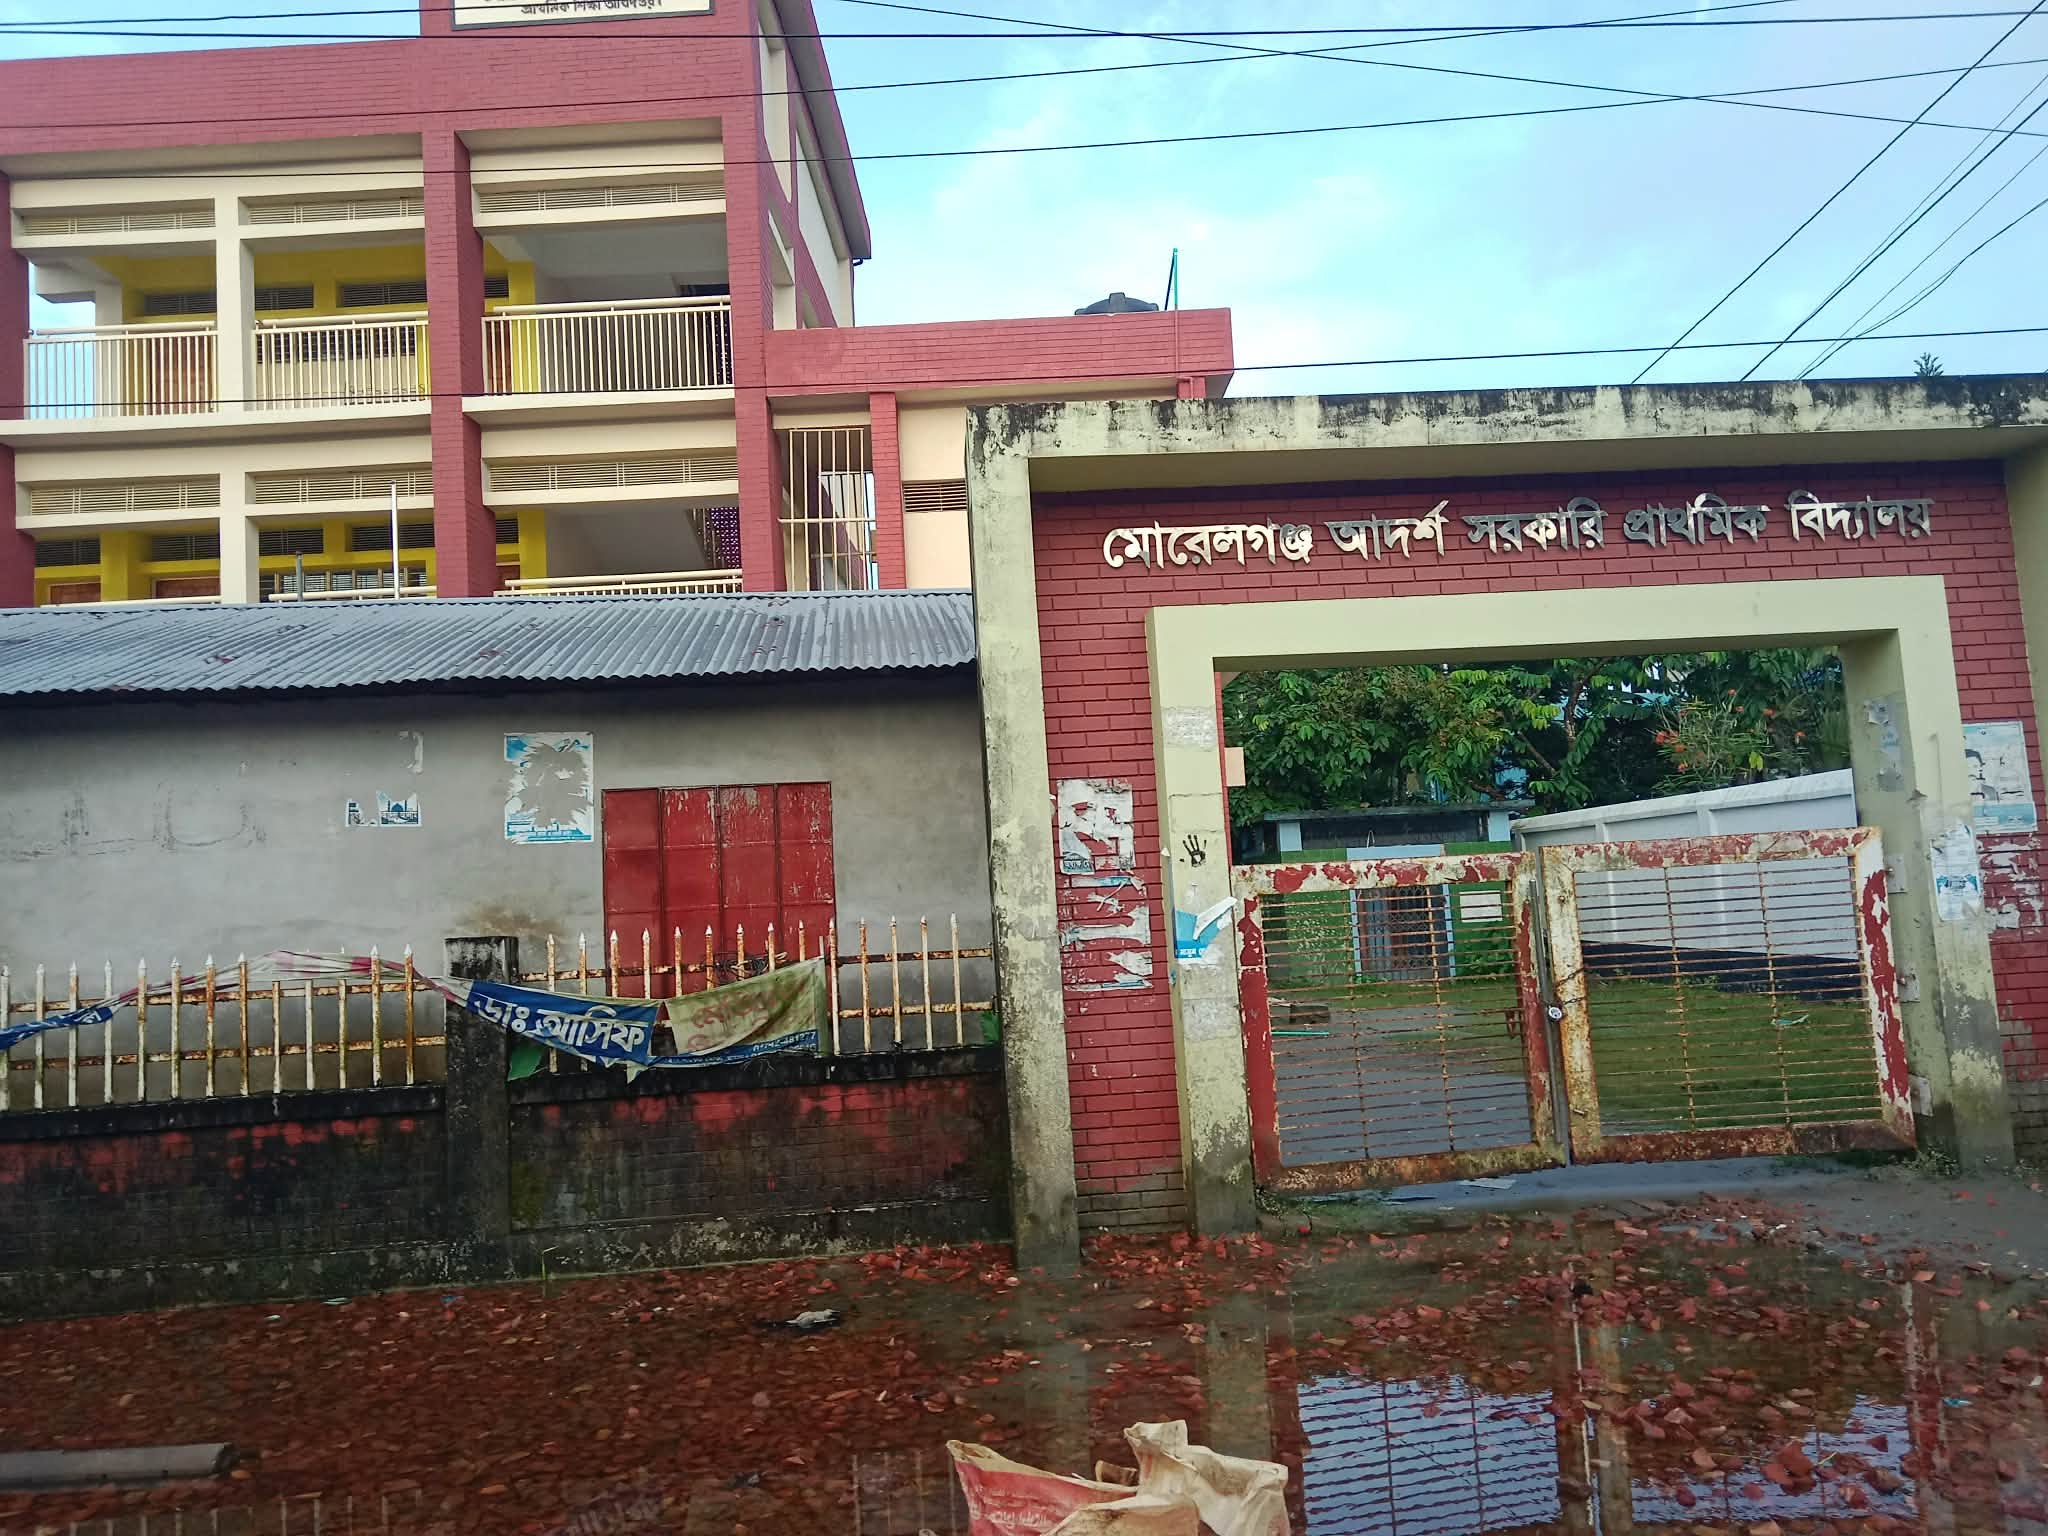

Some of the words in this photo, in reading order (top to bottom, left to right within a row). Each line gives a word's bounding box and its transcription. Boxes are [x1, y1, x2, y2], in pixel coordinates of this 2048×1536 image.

[1102, 515, 1315, 569] মোরেলগঞ্জ
[1324, 500, 1449, 561] আদর্শ
[1461, 496, 1608, 555] সরকারি
[1623, 492, 1772, 549] প্রাথমিক
[1784, 488, 1935, 544] বিদ্যালয়
[535, 1004, 649, 1053] আসিফ
